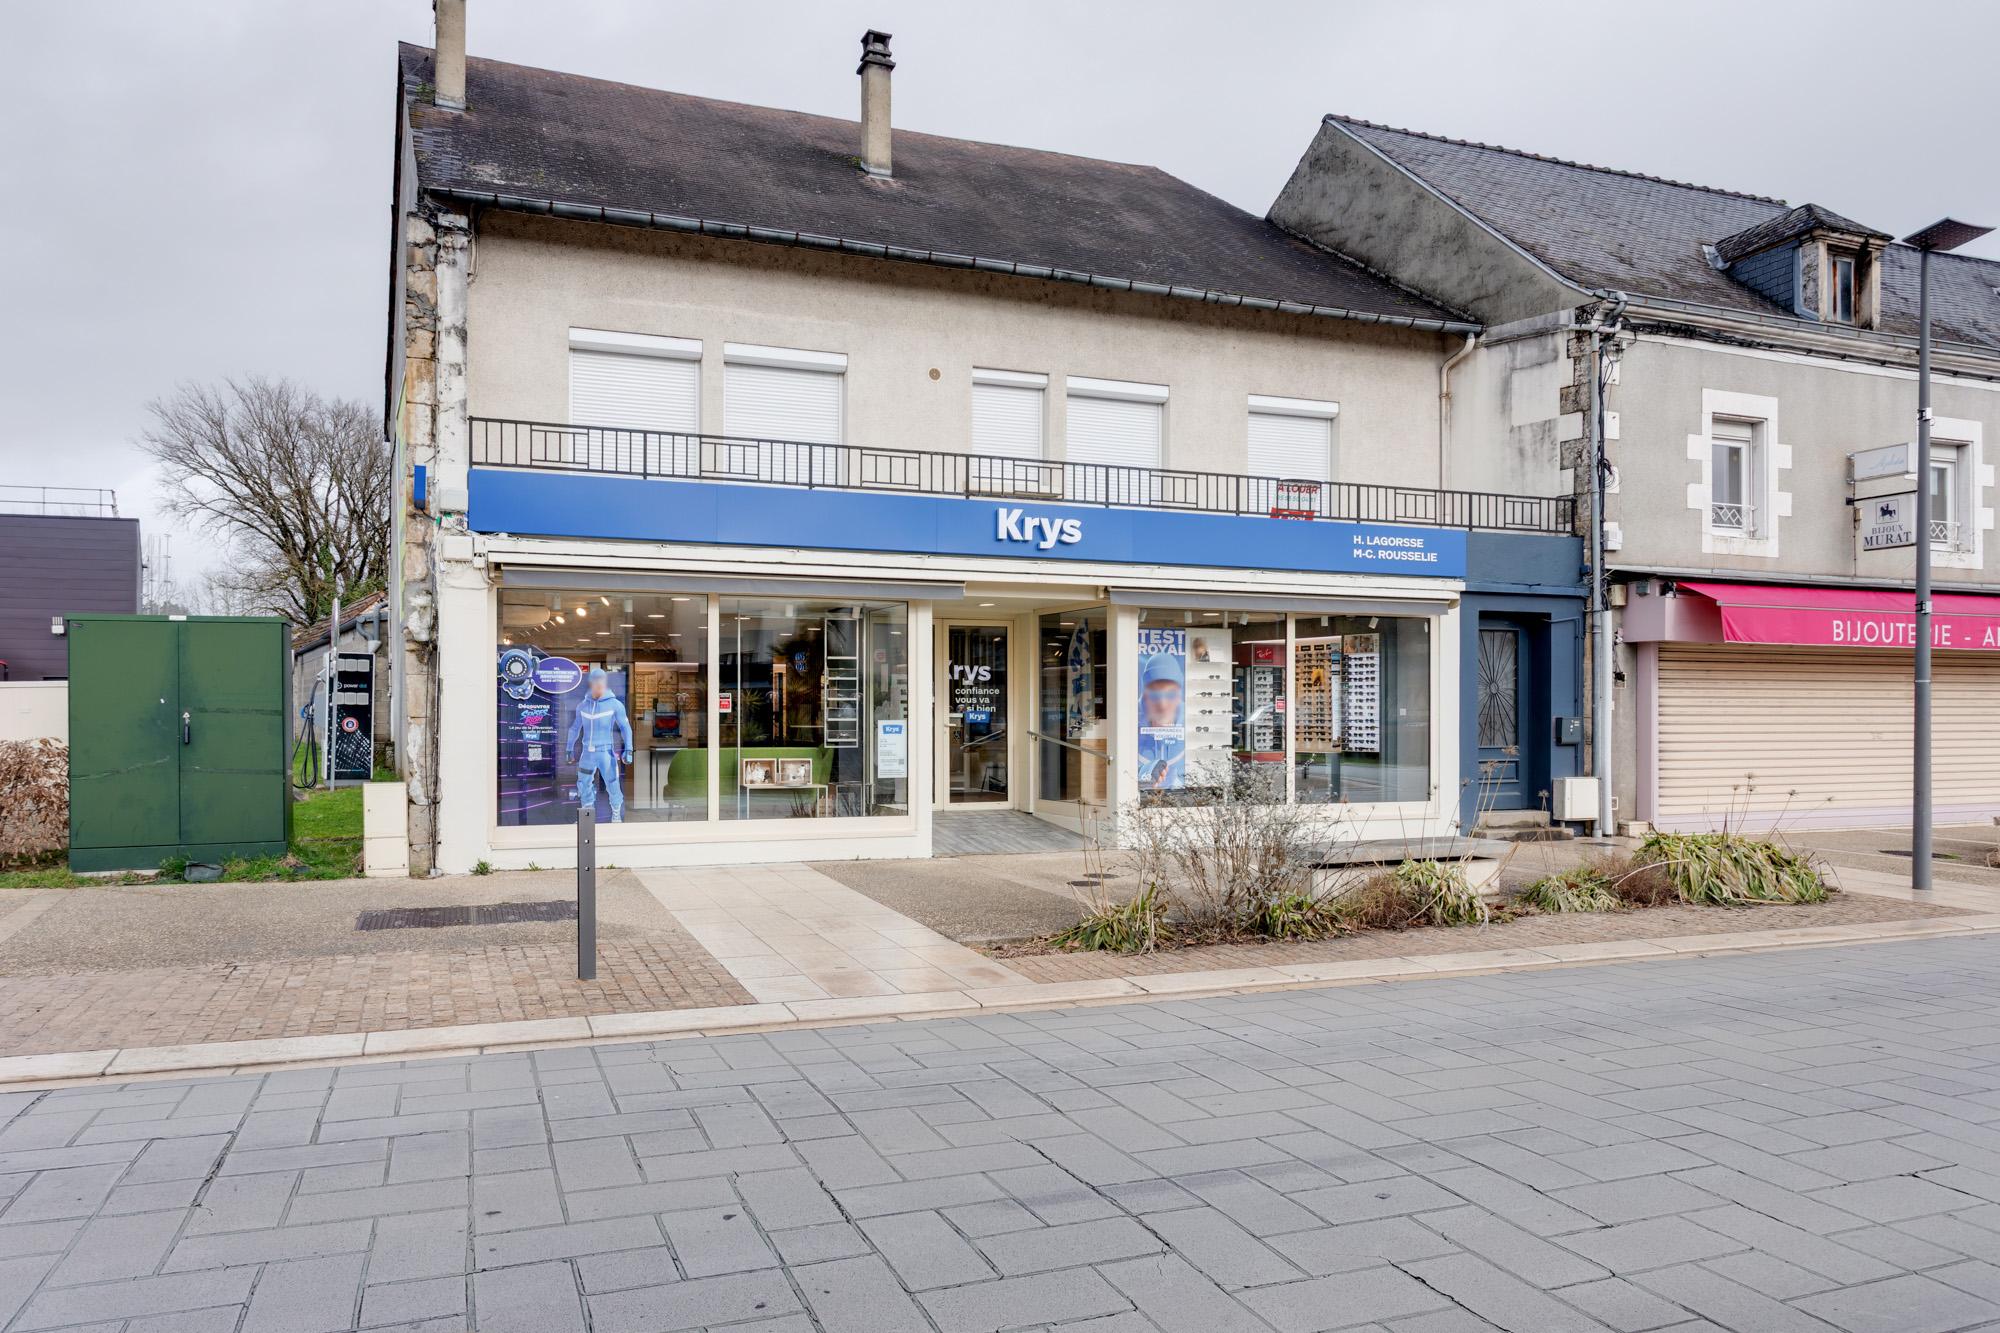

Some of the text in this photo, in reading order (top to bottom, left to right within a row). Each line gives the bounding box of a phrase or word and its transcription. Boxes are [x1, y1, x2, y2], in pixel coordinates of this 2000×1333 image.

[998, 507, 1082, 549] Krys
[1871, 524, 1904, 535] BIJOUX
[1353, 535, 1424, 548] H. LAGORSSE
[1864, 531, 1912, 547] MURAT
[1353, 549, 1438, 562] M-C. ROUSSELIE
[1138, 629, 1185, 644] TEST
[1833, 620, 1951, 645] BIJOUTEIE
[1138, 643, 1186, 656] ROYAL
[955, 686, 1000, 695] confiance
[966, 704, 997, 713] si bien
[969, 712, 986, 721] Krys
